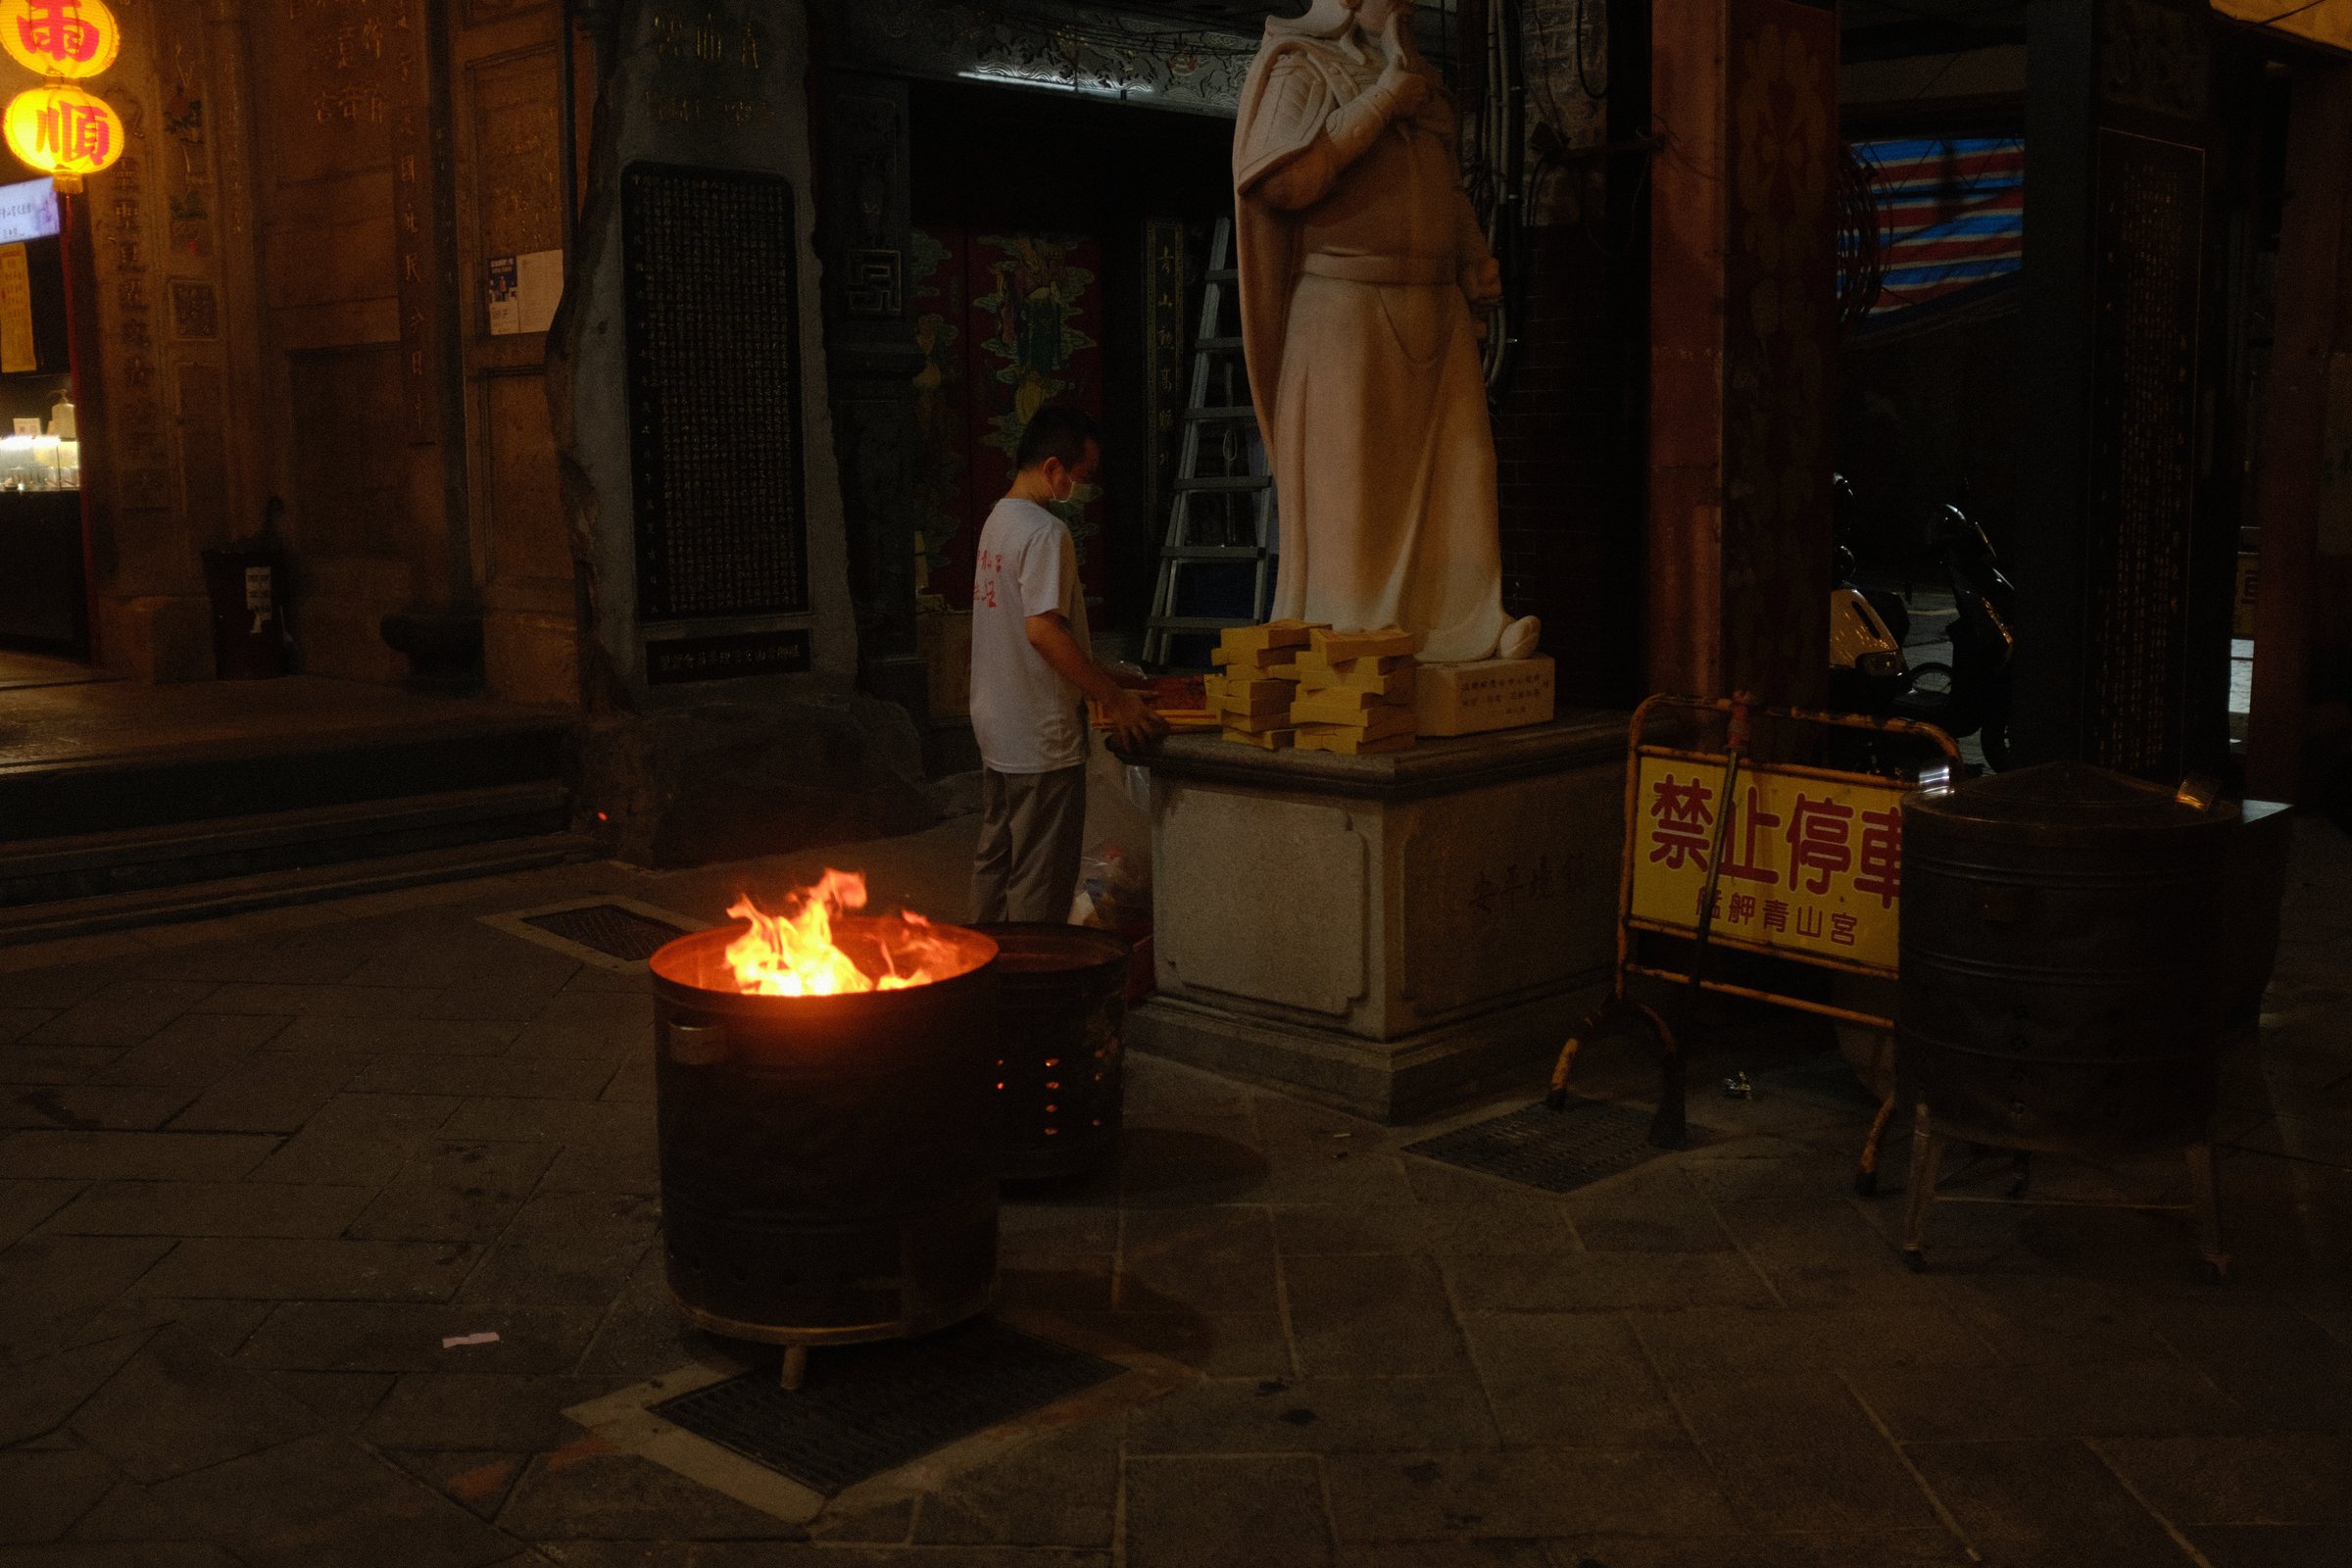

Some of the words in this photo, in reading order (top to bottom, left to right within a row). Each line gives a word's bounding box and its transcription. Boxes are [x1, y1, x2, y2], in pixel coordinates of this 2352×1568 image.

[17, 0, 100, 62] 雨
[35, 100, 110, 166] 順
[1649, 773, 1902, 909] 禁止停車
